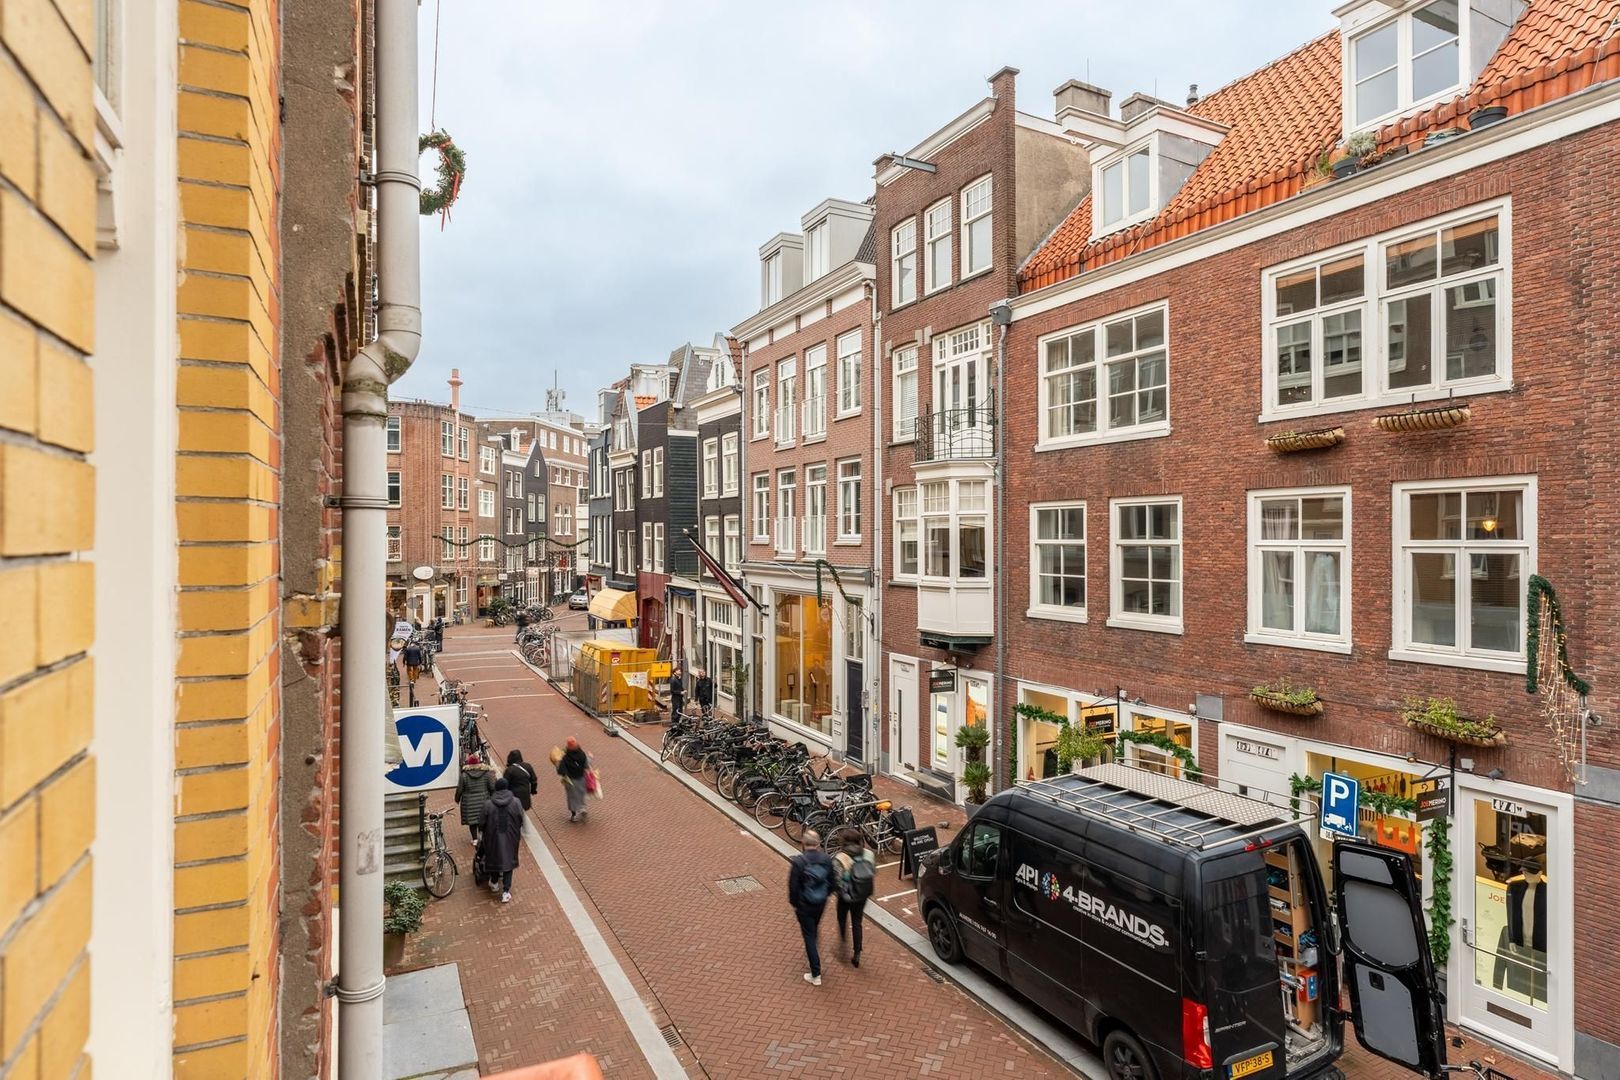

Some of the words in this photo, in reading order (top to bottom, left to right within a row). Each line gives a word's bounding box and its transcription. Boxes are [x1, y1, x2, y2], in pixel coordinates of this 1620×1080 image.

[1330, 779, 1349, 807] P
[1016, 863, 1038, 886] API
[1488, 892, 1505, 904] JOE
